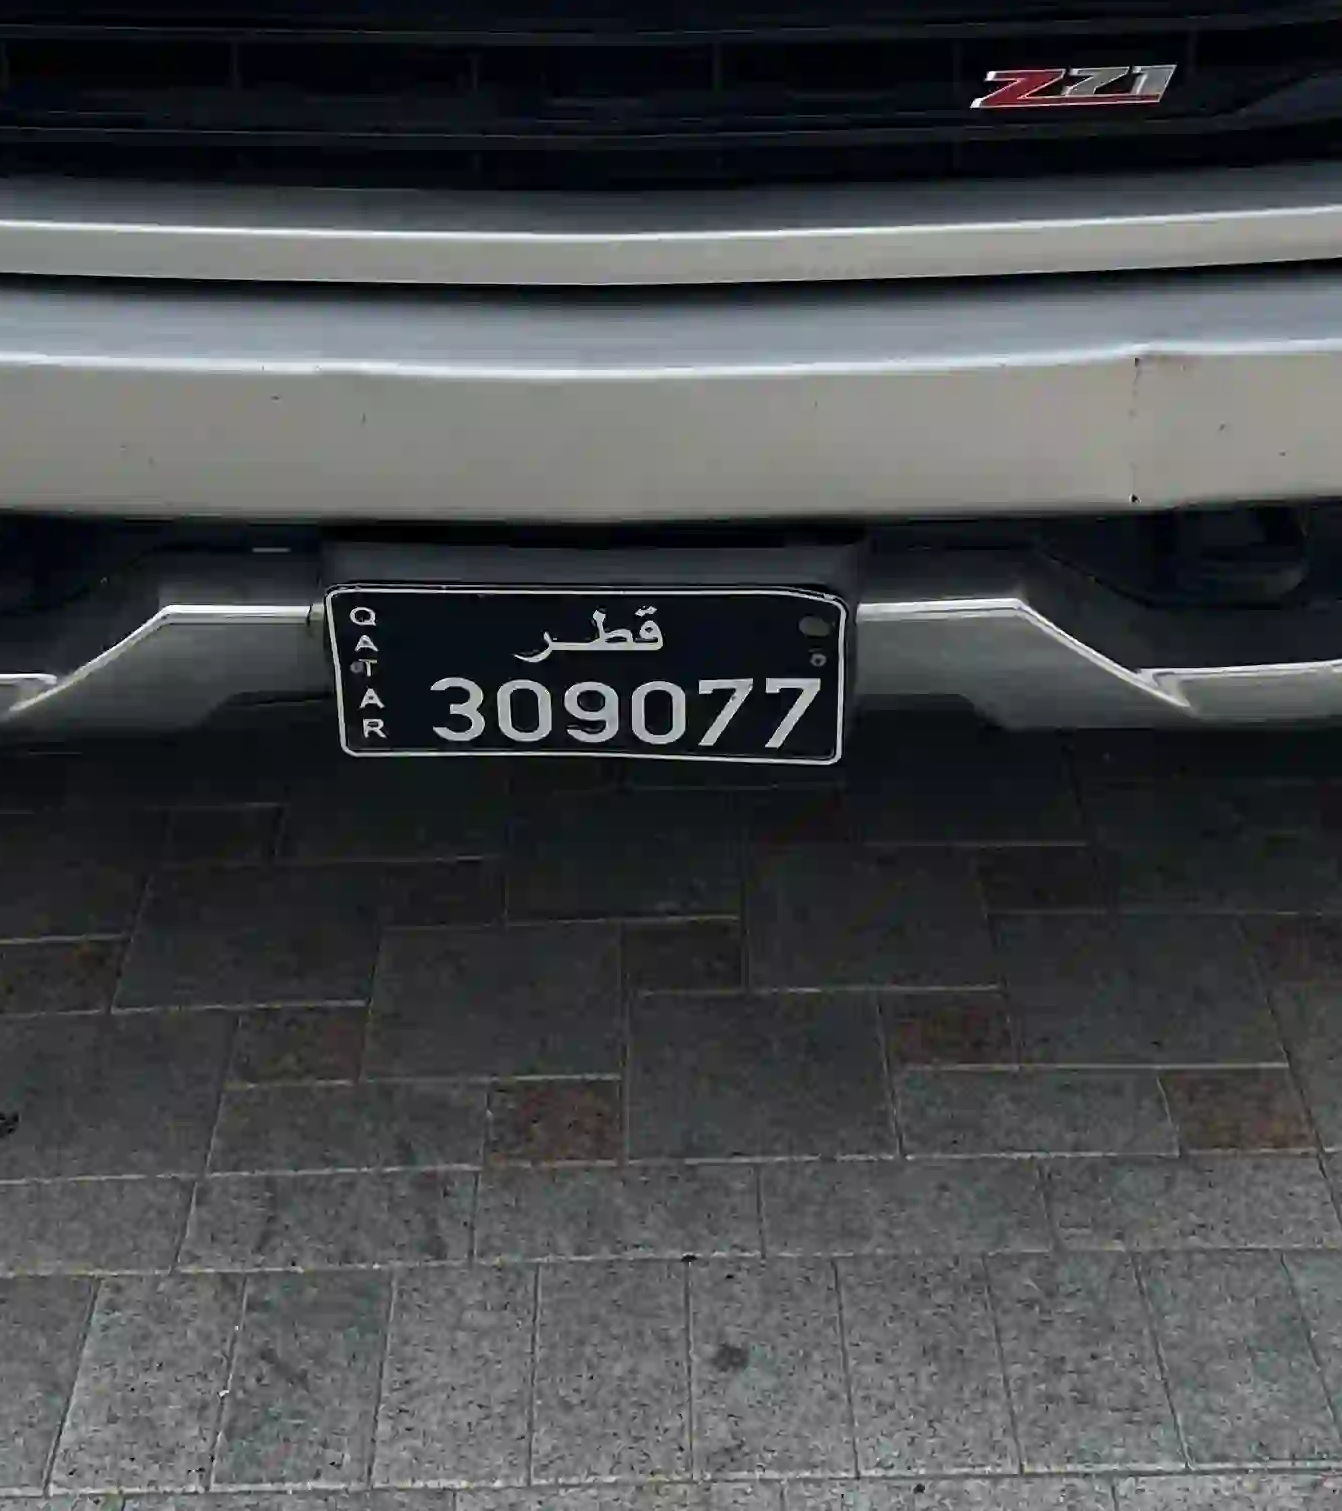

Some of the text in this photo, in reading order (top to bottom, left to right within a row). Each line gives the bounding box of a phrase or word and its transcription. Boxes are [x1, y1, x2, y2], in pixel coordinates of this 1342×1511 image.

[512, 604, 665, 663] قطر
[348, 605, 387, 739] QATAR
[429, 676, 823, 749] 309077
